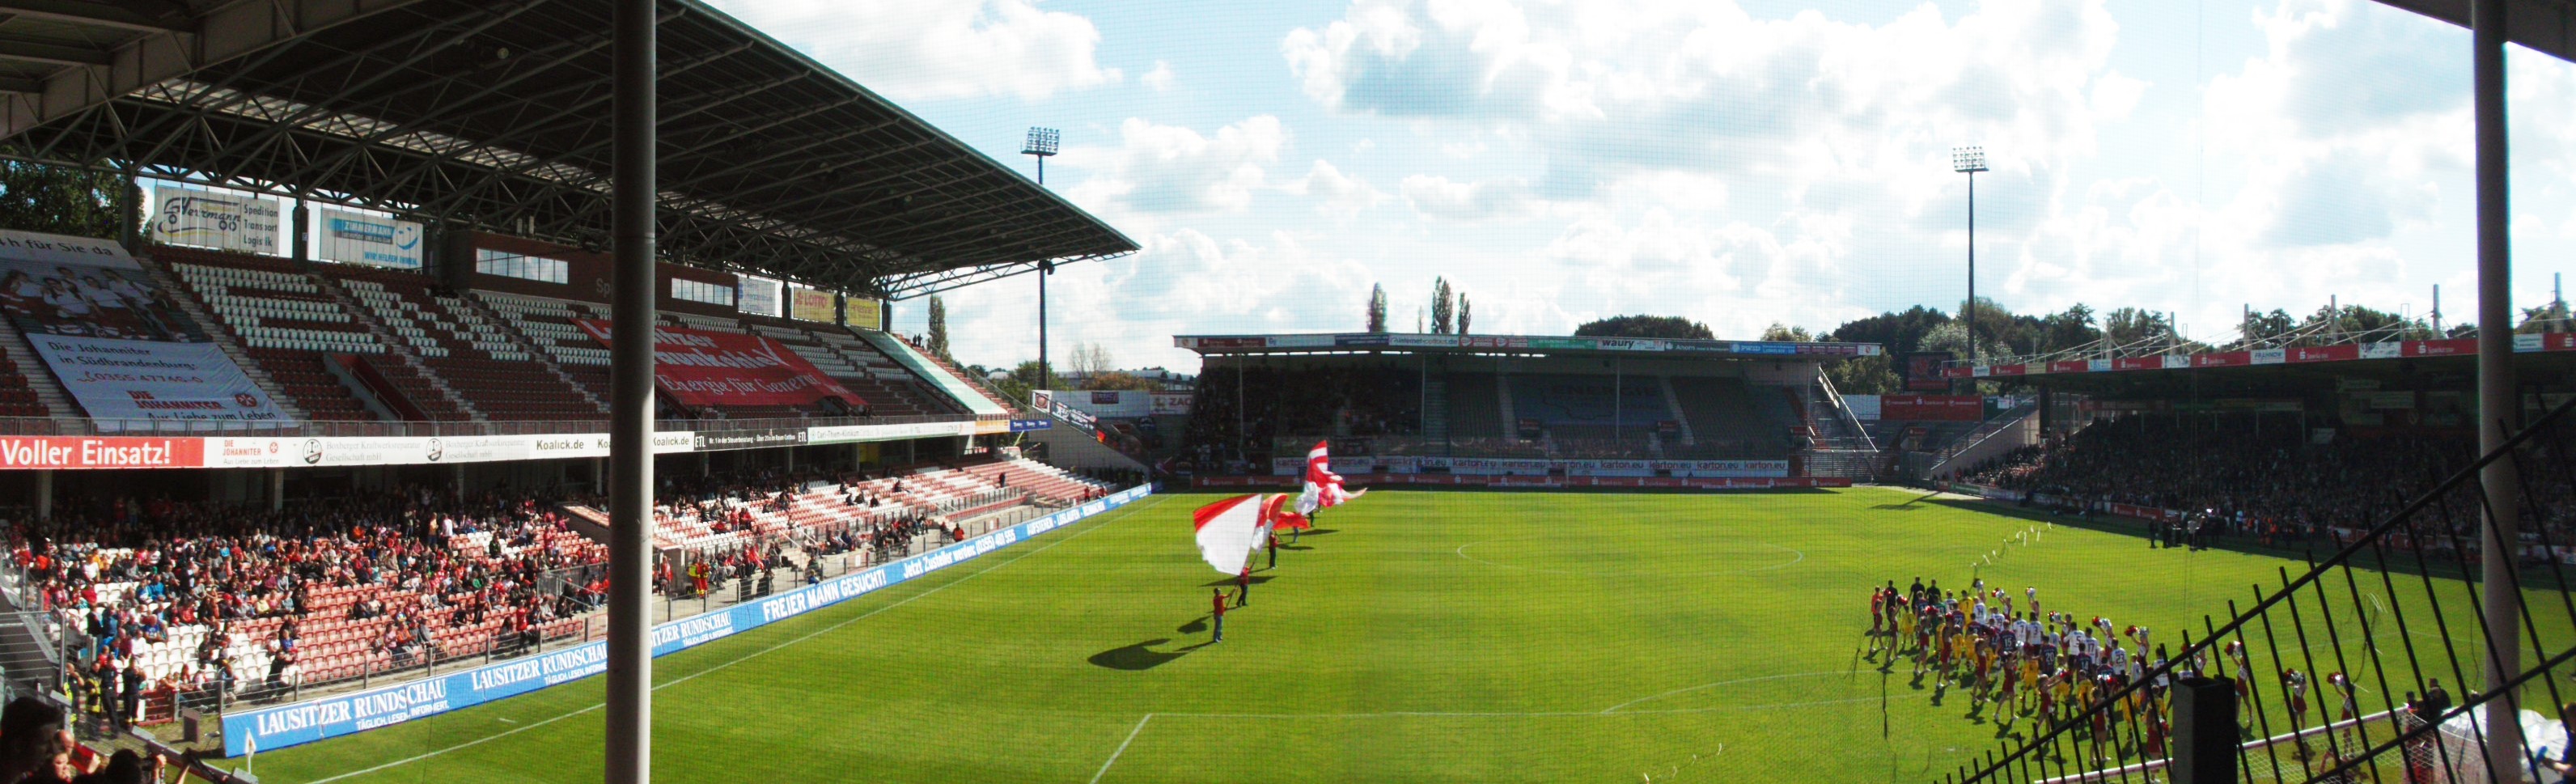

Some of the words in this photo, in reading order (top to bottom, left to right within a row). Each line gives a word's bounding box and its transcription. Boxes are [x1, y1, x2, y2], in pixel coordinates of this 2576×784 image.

[244, 204, 278, 217] Spedition
[244, 235, 273, 247] Logisik
[25, 239, 53, 250] für
[57, 242, 87, 252] Sie
[91, 245, 113, 256] da
[364, 251, 377, 260] WIR
[804, 296, 828, 309] LOTTO
[47, 341, 72, 352] Die
[78, 344, 151, 356] Johanniter
[1602, 339, 1634, 349] waury
[58, 354, 74, 363] in
[656, 373, 728, 395] Energie
[728, 375, 760, 395] für
[127, 390, 155, 400] DIE
[240, 410, 276, 420] Leben
[695, 435, 705, 448] ETL
[728, 434, 753, 444] Steuerberatung
[798, 431, 807, 443] ETL
[224, 439, 234, 447] DIE
[326, 441, 360, 451] Boxberger
[361, 441, 421, 451] Kraftwerksreparatur
[446, 439, 473, 449] Boxberger
[536, 439, 584, 451] Koalick.de
[1, 439, 73, 465] Voller
[82, 439, 171, 465] Einsatz!
[222, 448, 261, 456] JOHANNITER
[445, 451, 478, 460] Gesellschaft
[325, 453, 365, 462] Gesellschaft
[1697, 460, 1739, 469] karton.eu
[1744, 460, 1786, 469] karton.eu
[904, 559, 923, 578] Jetzt
[922, 551, 953, 572] Zusteller
[762, 592, 807, 621] FREIER
[807, 581, 840, 608] MANN
[840, 568, 887, 597] GESUCHT!
[680, 610, 731, 638] RUNDSCHAU
[2019, 625, 2024, 634] 7
[2033, 626, 2038, 634] 3
[2005, 638, 2012, 646] 15
[2045, 652, 2054, 662] 20
[2116, 655, 2125, 664] 23
[471, 659, 540, 691] LAUSITZER
[256, 697, 352, 736] LAUSITZER
[354, 679, 447, 718] RUNDSCHAU
[410, 699, 450, 718] INFORMIERT.
